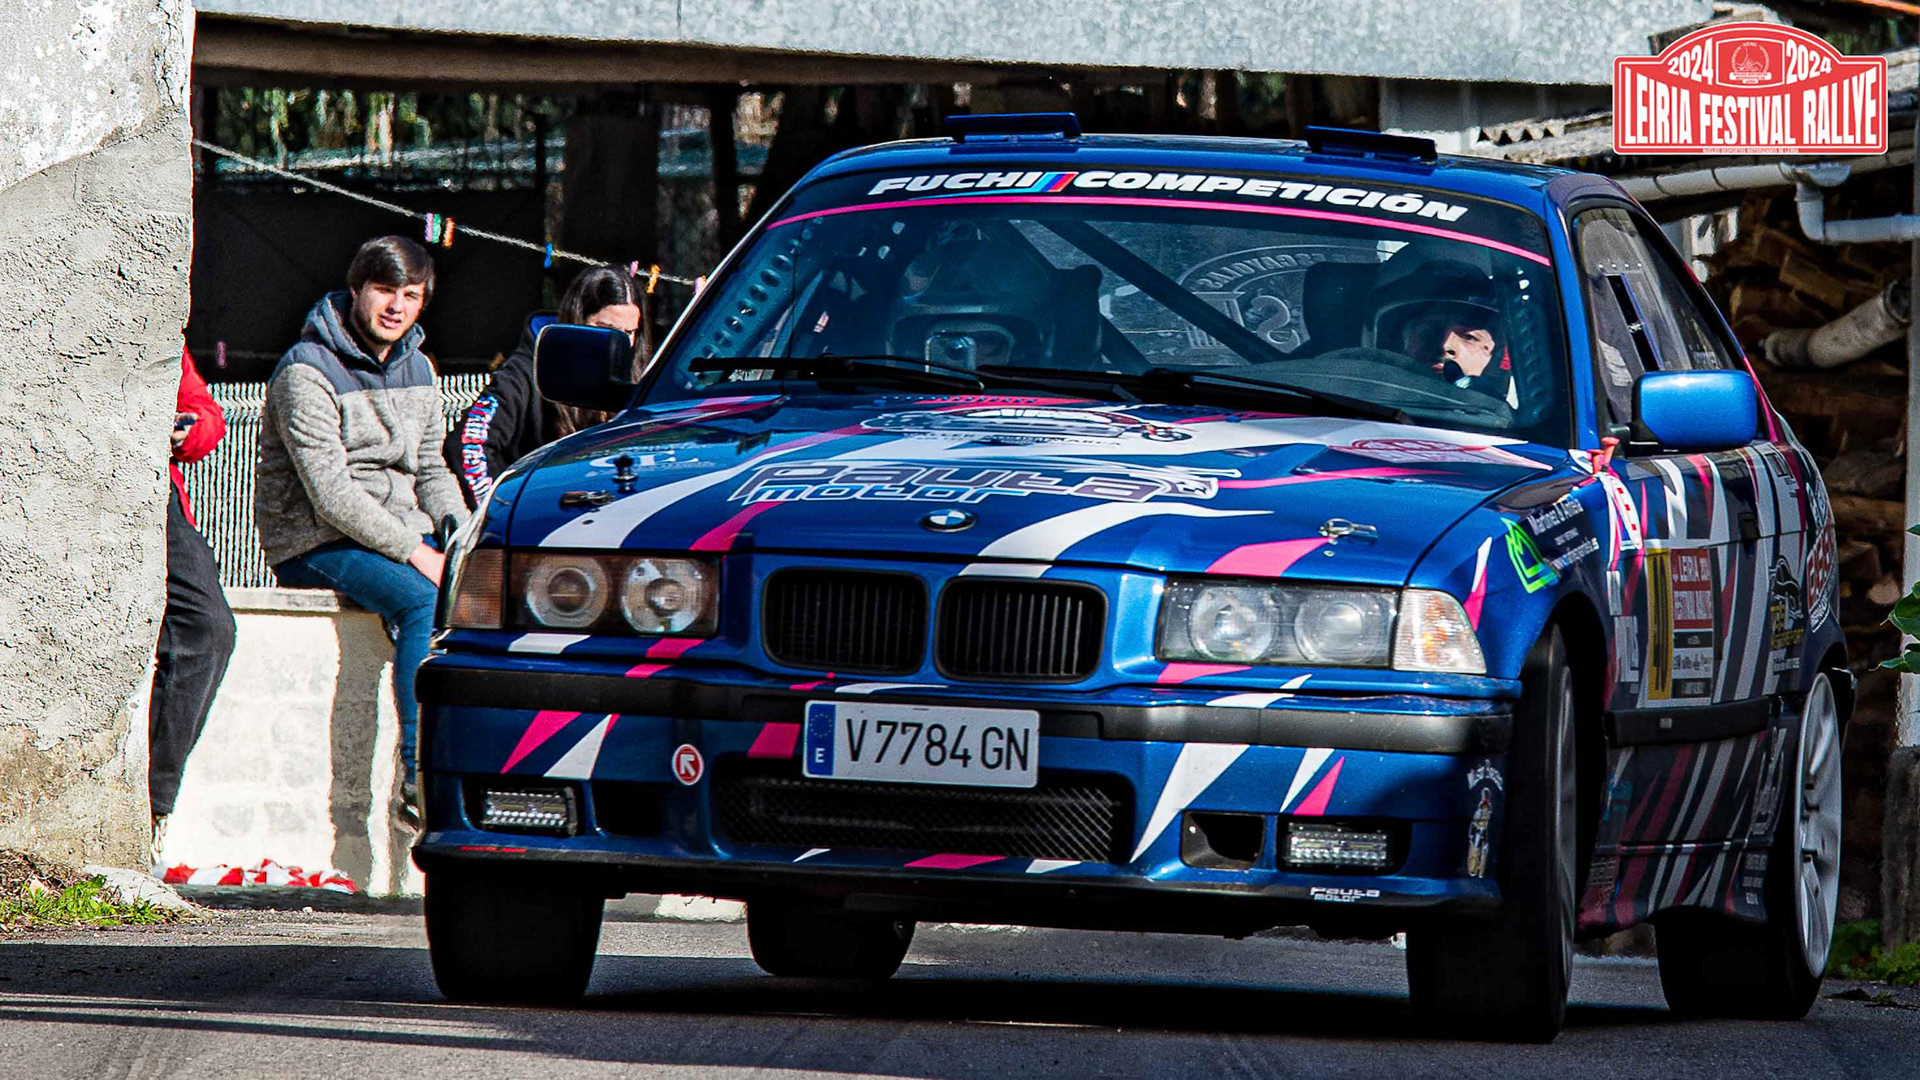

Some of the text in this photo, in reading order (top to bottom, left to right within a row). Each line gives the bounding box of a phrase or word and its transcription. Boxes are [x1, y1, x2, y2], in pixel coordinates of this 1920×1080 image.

[866, 169, 1470, 224] FUCHI COMPETICIÓN
[814, 747, 825, 764] E
[846, 717, 1031, 772] V 7784 GN
